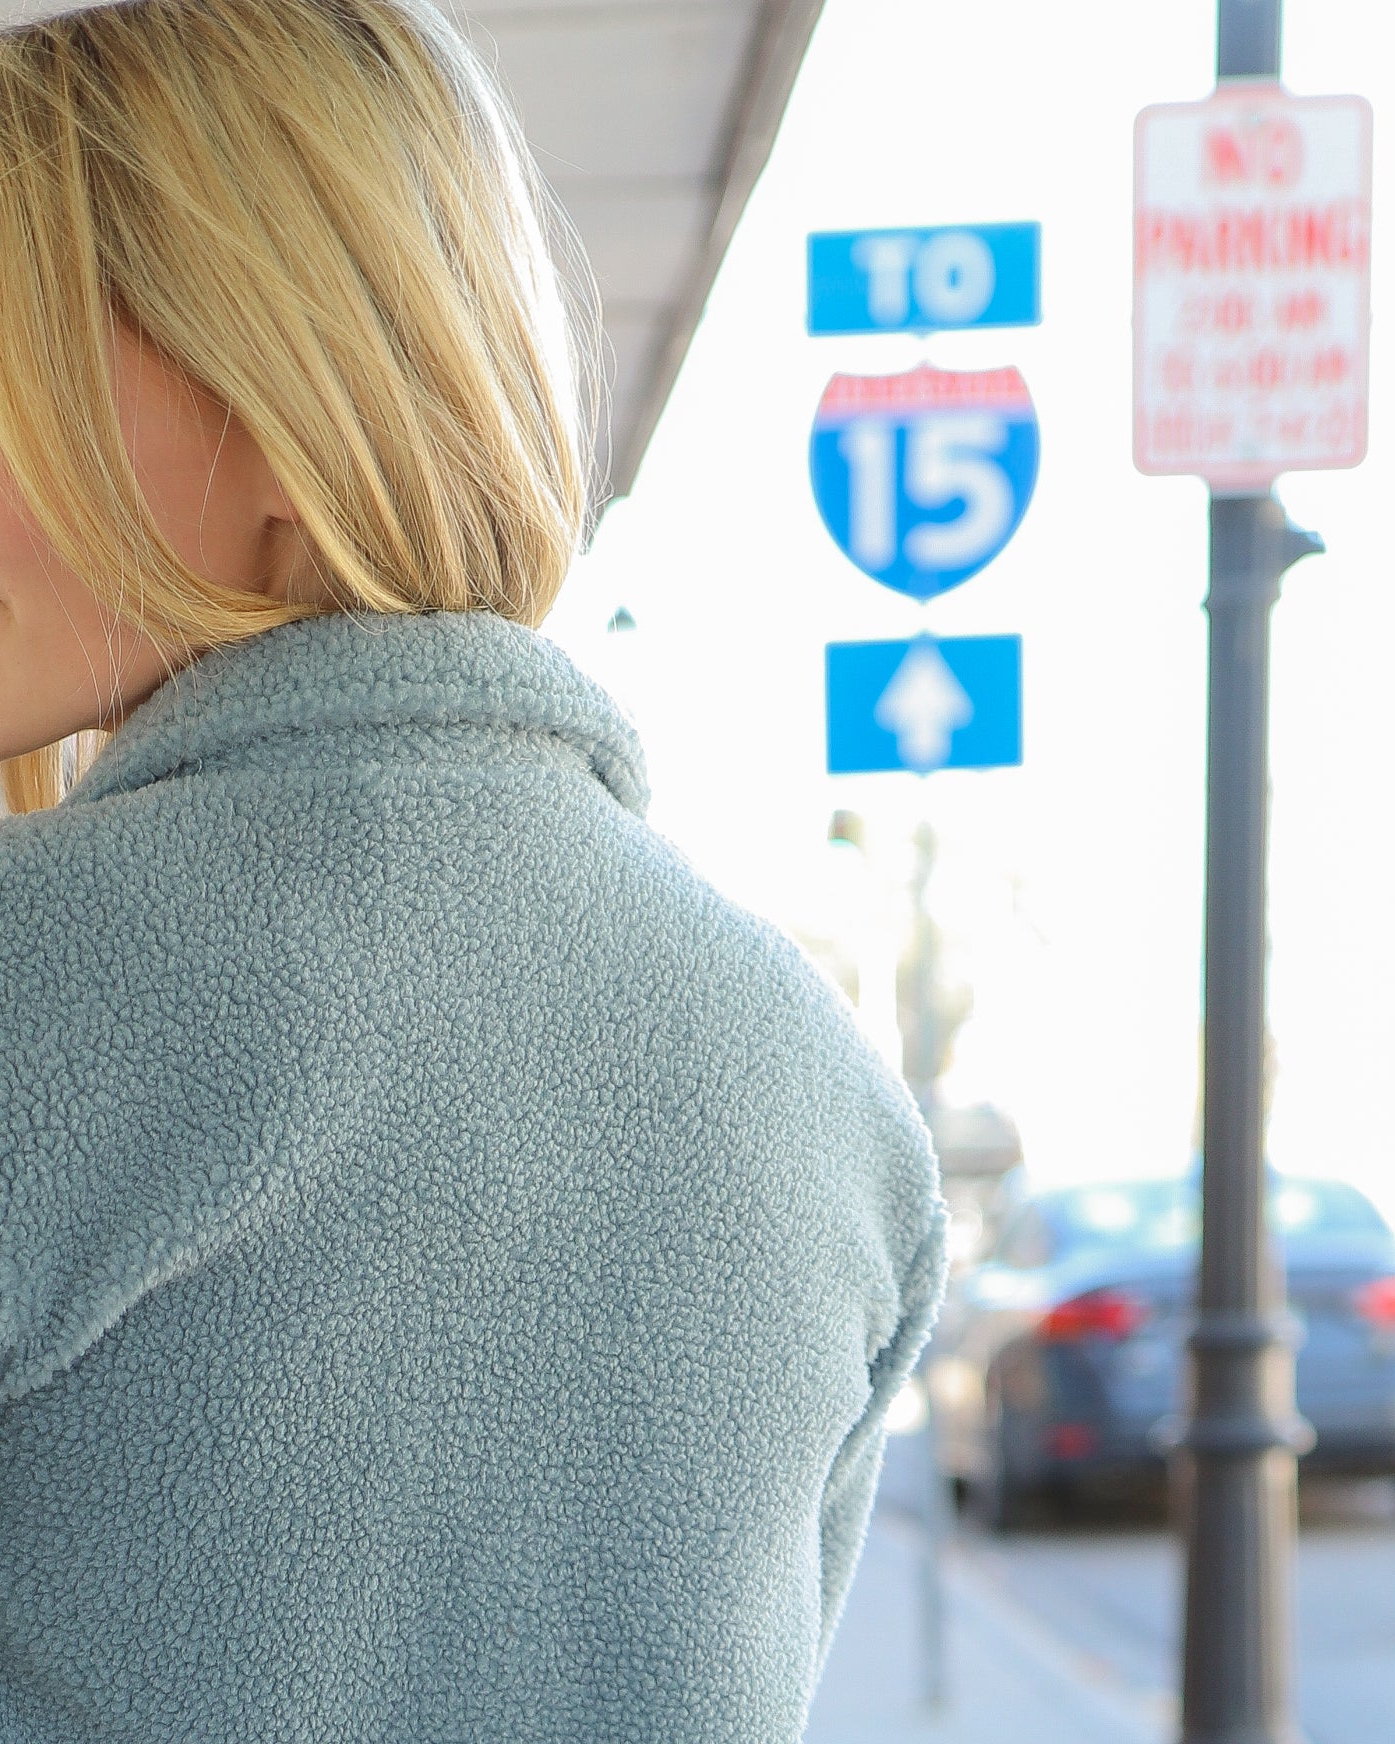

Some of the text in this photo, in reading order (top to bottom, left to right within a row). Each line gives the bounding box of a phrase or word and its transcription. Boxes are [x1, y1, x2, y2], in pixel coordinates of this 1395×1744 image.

[1200, 118, 1306, 190] NO
[1139, 203, 1369, 274] PARKING
[837, 413, 1015, 573] 15
